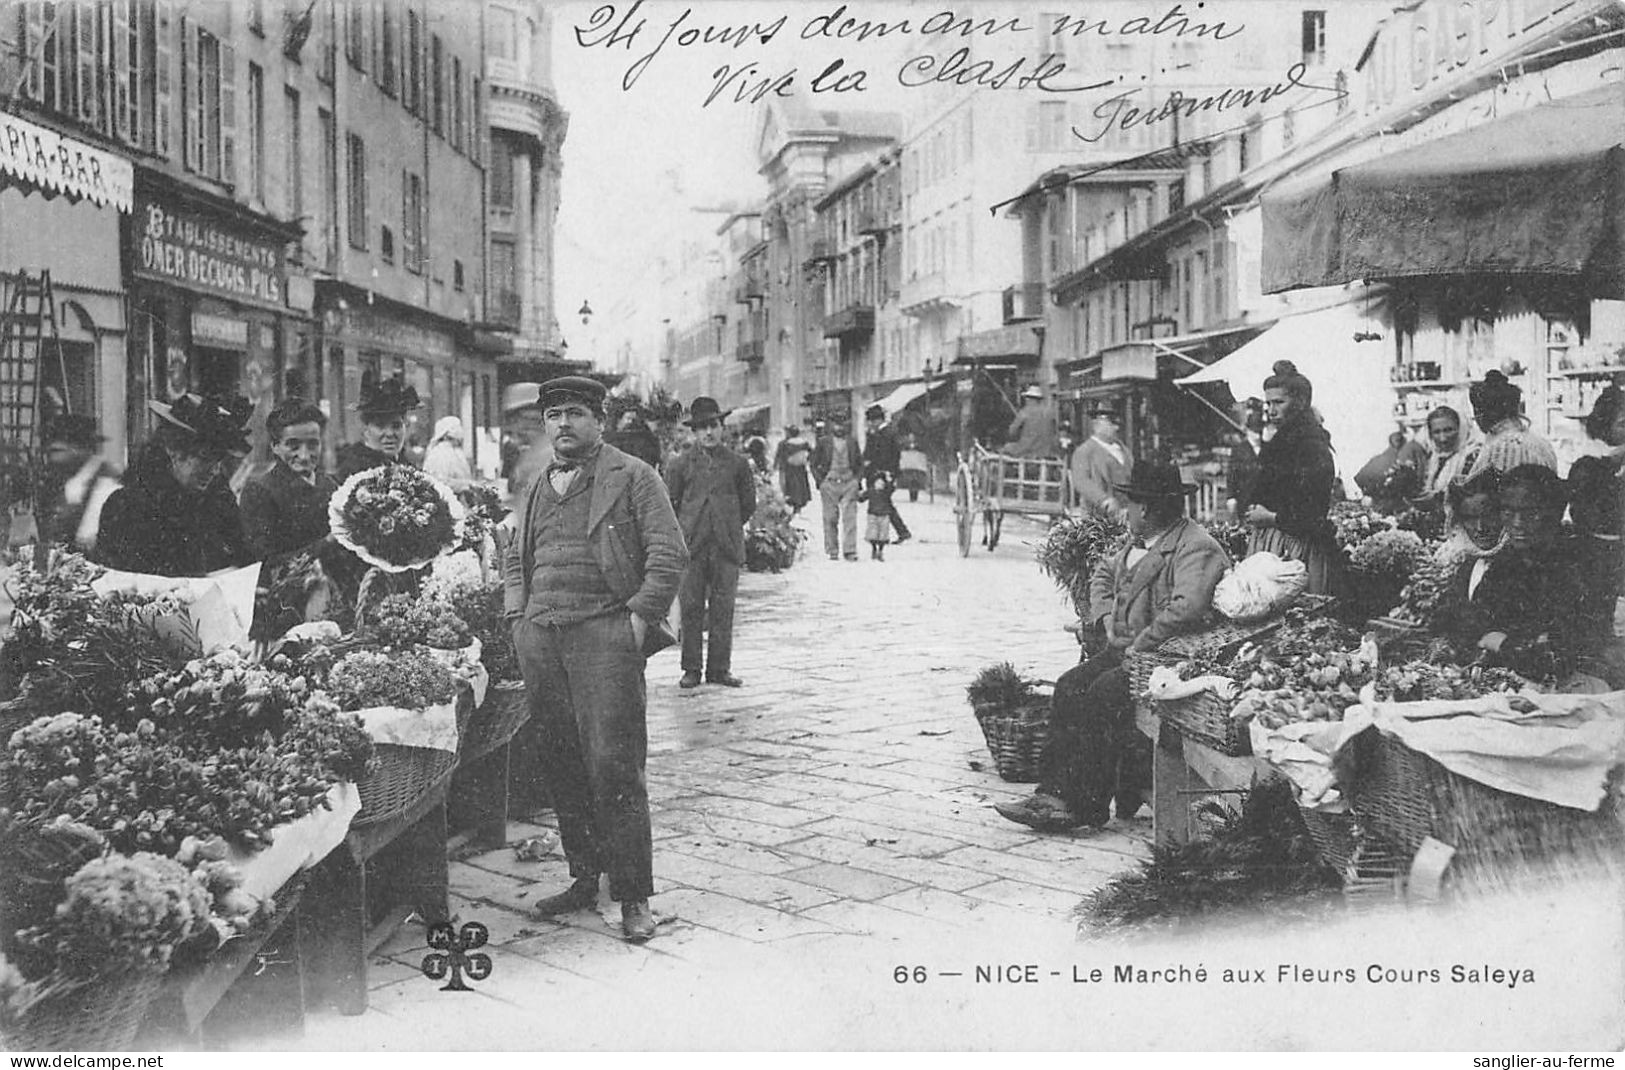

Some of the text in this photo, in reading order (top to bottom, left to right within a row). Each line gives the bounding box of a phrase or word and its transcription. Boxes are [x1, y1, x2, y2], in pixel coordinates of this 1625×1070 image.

[575, 0, 647, 49] 24
[622, 9, 788, 91] jours
[1052, 2, 1246, 40] matin
[702, 61, 798, 108] Vive
[811, 58, 867, 93] la
[0, 124, 107, 190] PIA-BAR
[142, 236, 186, 278] OMER
